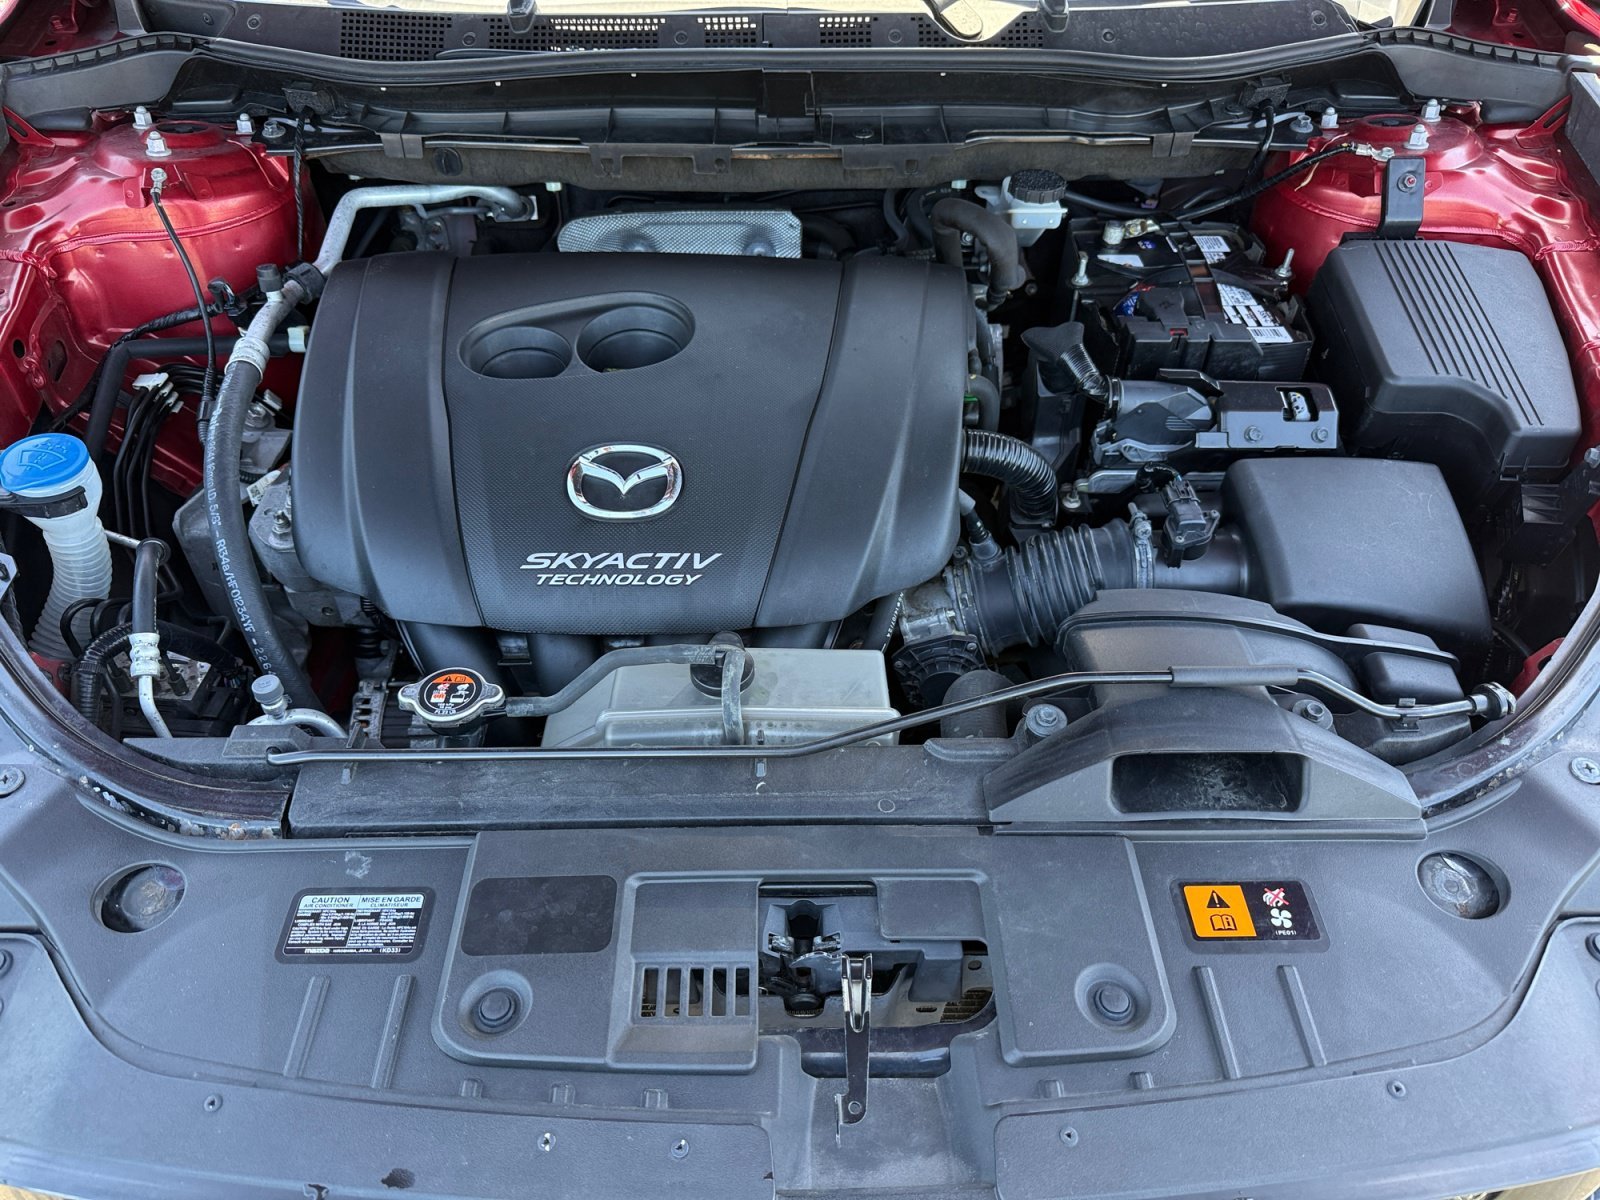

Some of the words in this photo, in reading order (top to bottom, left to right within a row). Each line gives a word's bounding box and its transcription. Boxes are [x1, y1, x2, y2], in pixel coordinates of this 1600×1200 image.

[519, 552, 723, 570] SKYACTIV
[536, 573, 703, 586] TECHNOLOGY
[311, 896, 350, 904] CAUTION
